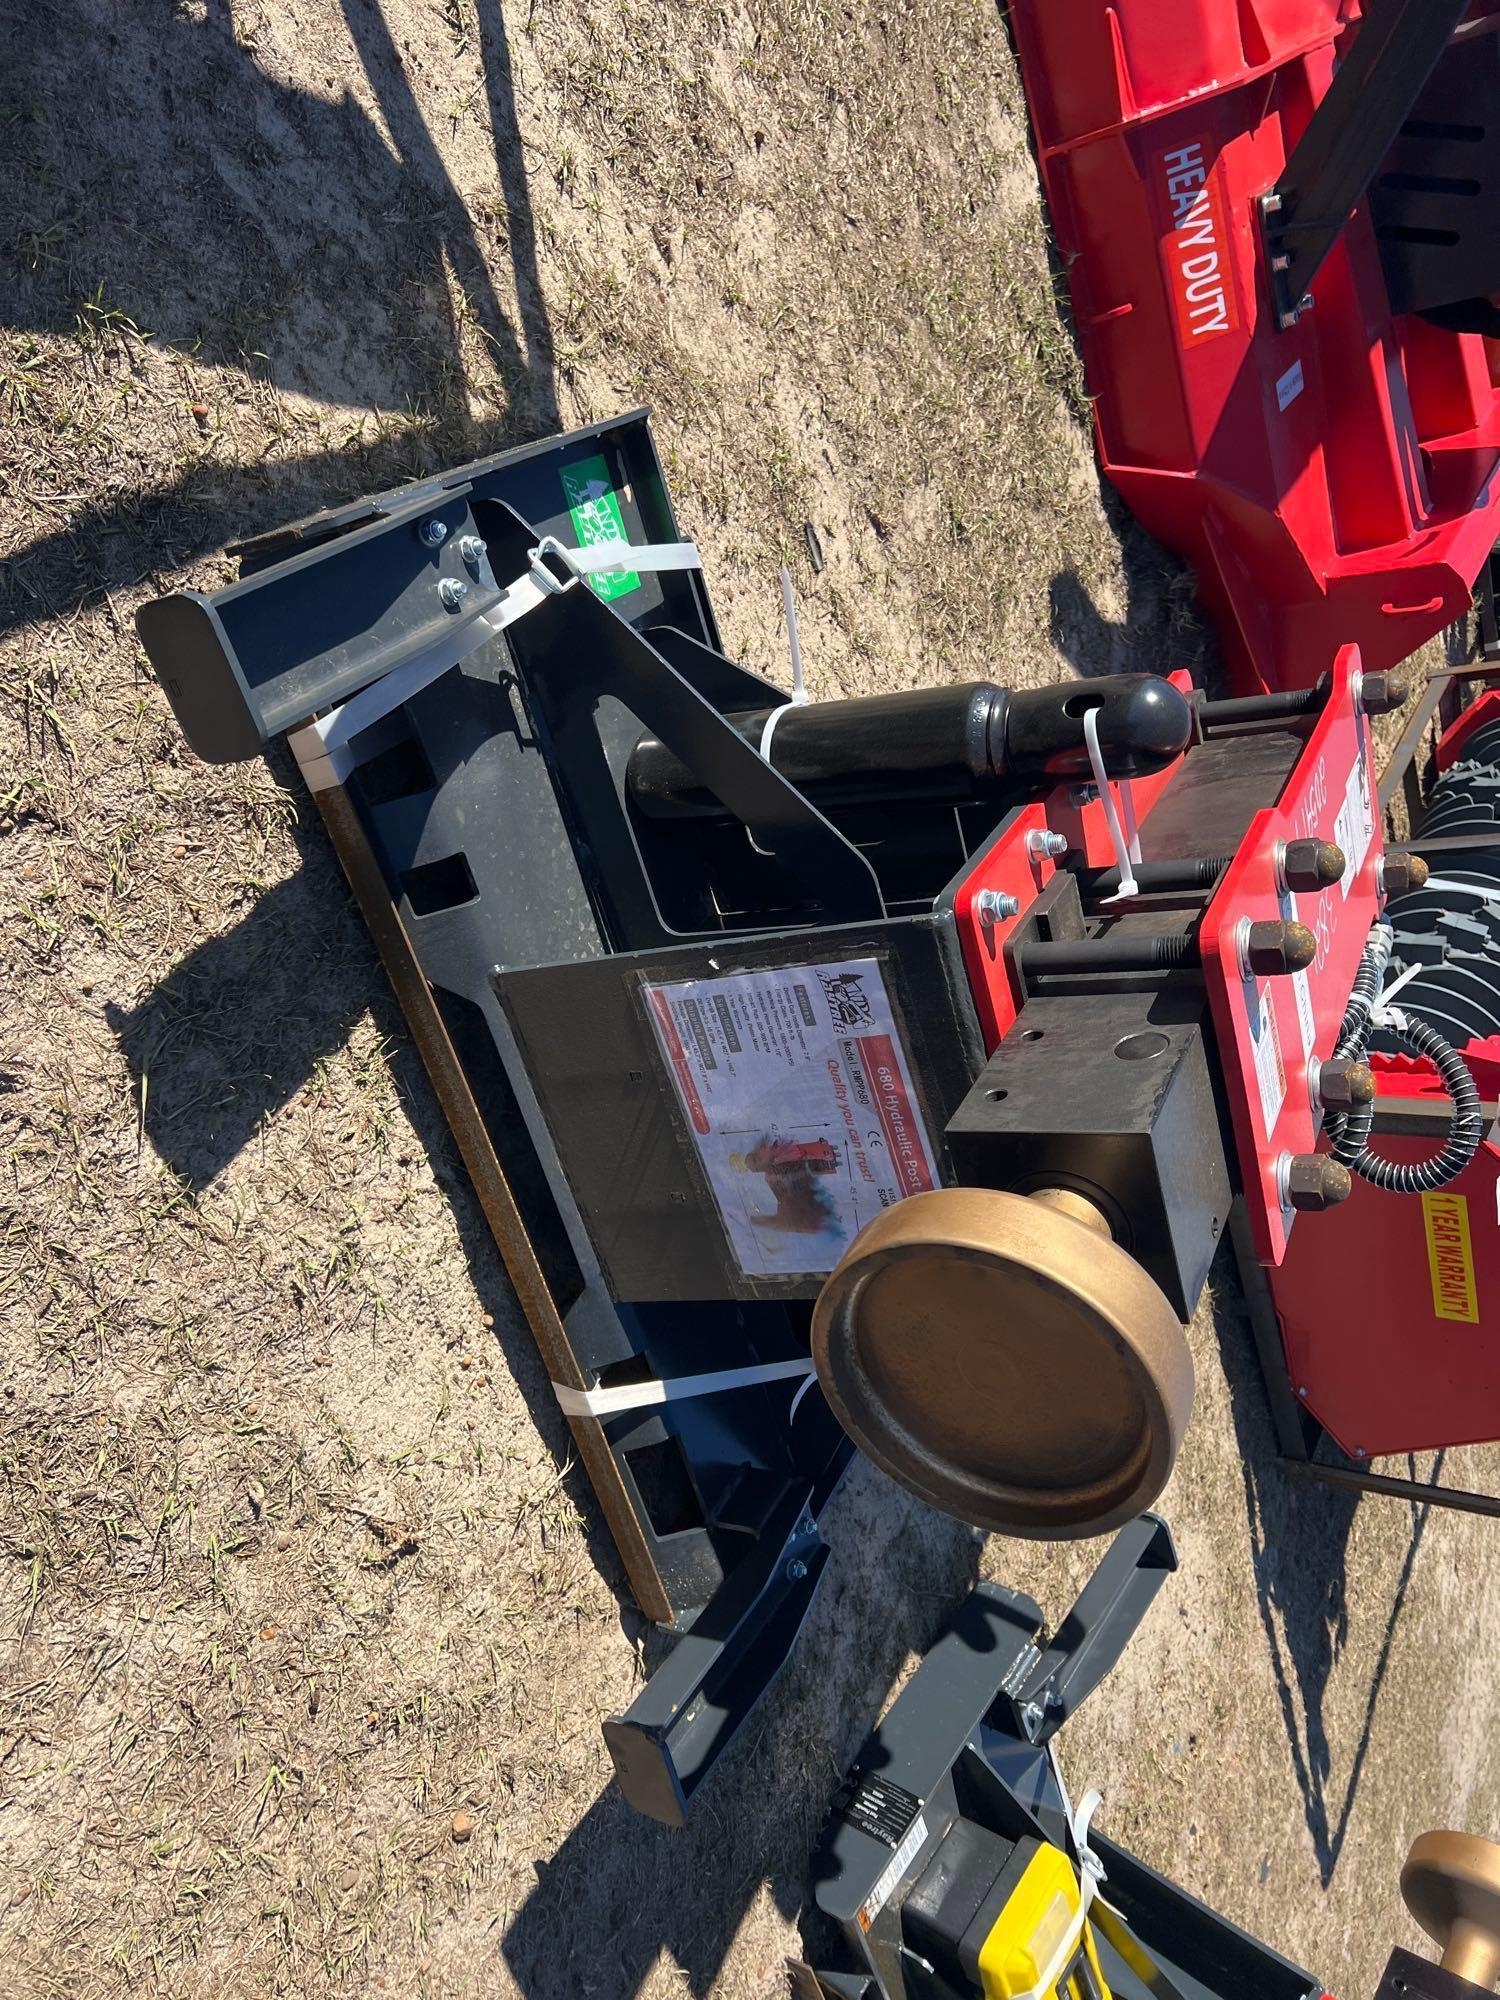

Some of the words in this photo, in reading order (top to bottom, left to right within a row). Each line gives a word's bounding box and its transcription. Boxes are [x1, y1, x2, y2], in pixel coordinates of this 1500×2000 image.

[1163, 143, 1216, 249] HEAVY
[1180, 252, 1229, 335] DUTY
[824, 1059, 850, 1102] Quality
[876, 1066, 895, 1090] 680
[837, 1103, 855, 1126] you
[881, 1094, 915, 1156] Hydraulic
[847, 1128, 862, 1148] can
[854, 1151, 875, 1183] trust!
[904, 1159, 924, 1187] Post
[877, 1188, 890, 1207] SCAN
[1431, 1208, 1461, 1243] YEAR
[1435, 1245, 1469, 1317] WARRANTY
